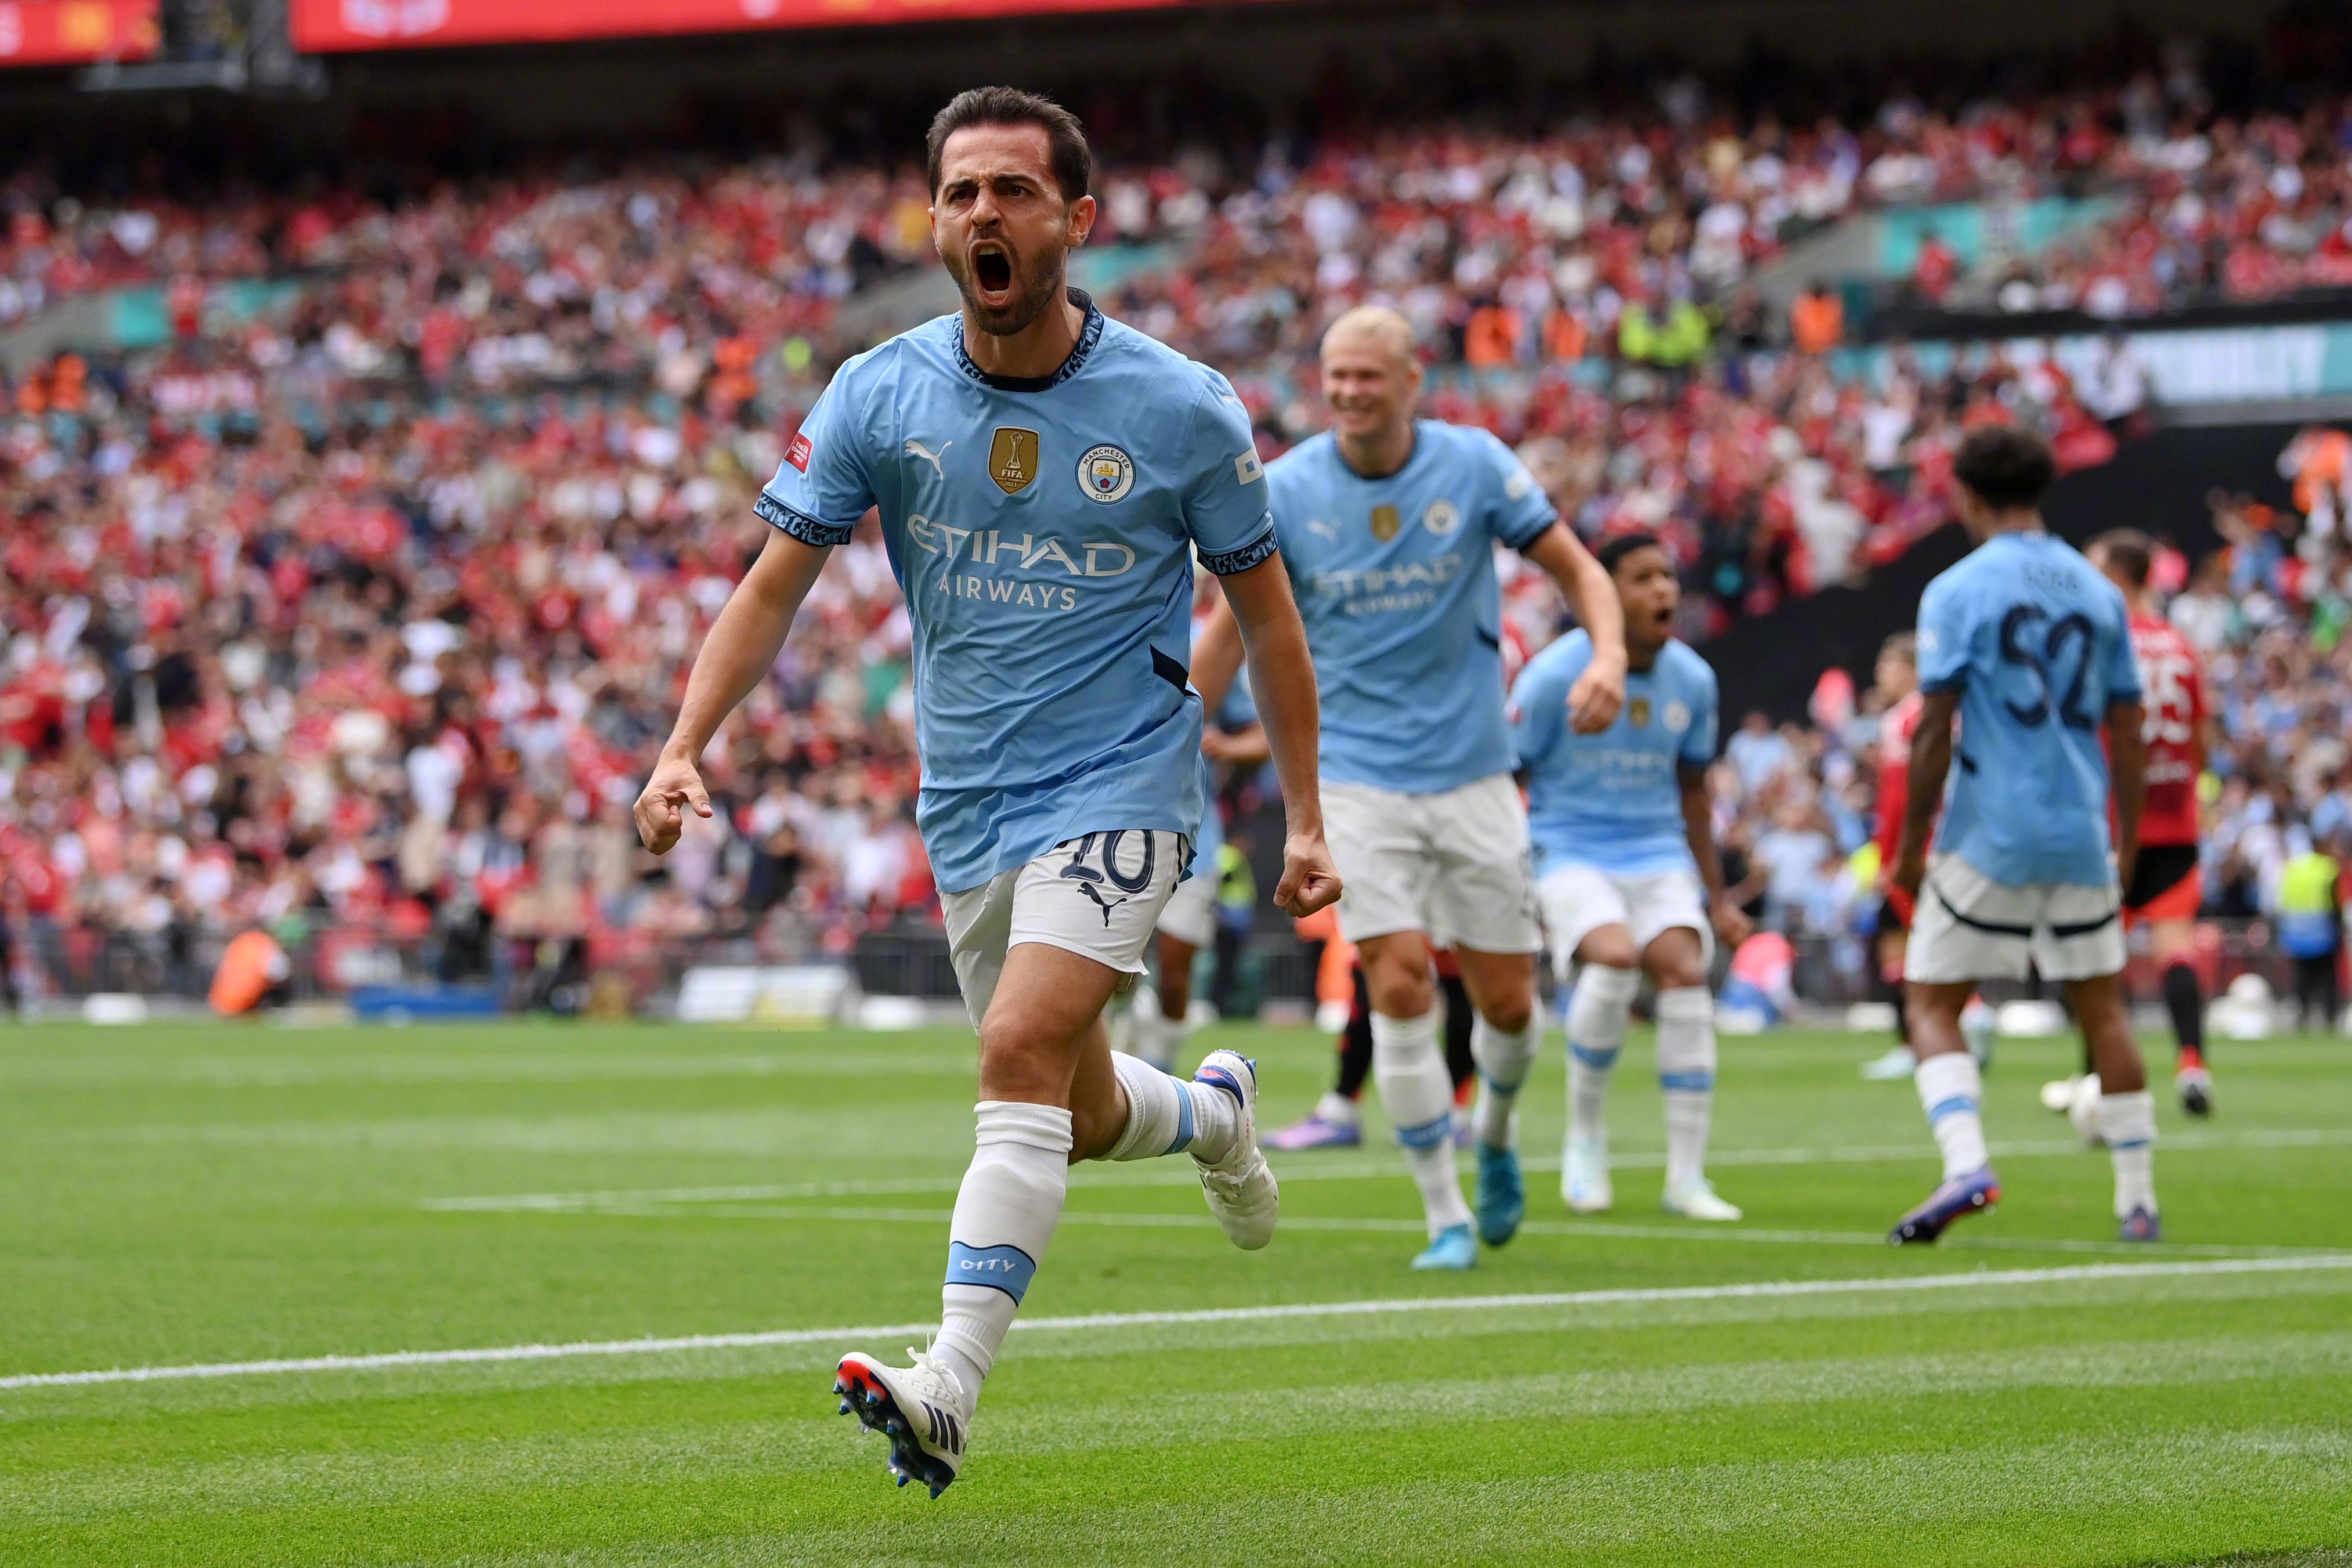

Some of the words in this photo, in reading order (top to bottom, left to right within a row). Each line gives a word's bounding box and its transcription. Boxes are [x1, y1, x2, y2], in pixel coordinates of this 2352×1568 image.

[1083, 449, 1130, 469] MANCHESTER
[1001, 469, 1023, 479] FIFA
[908, 514, 1136, 577] ETIHAD
[939, 572, 1076, 610] AIRWAYS
[2000, 604, 2094, 729] 52
[960, 1259, 1016, 1272] CITY
